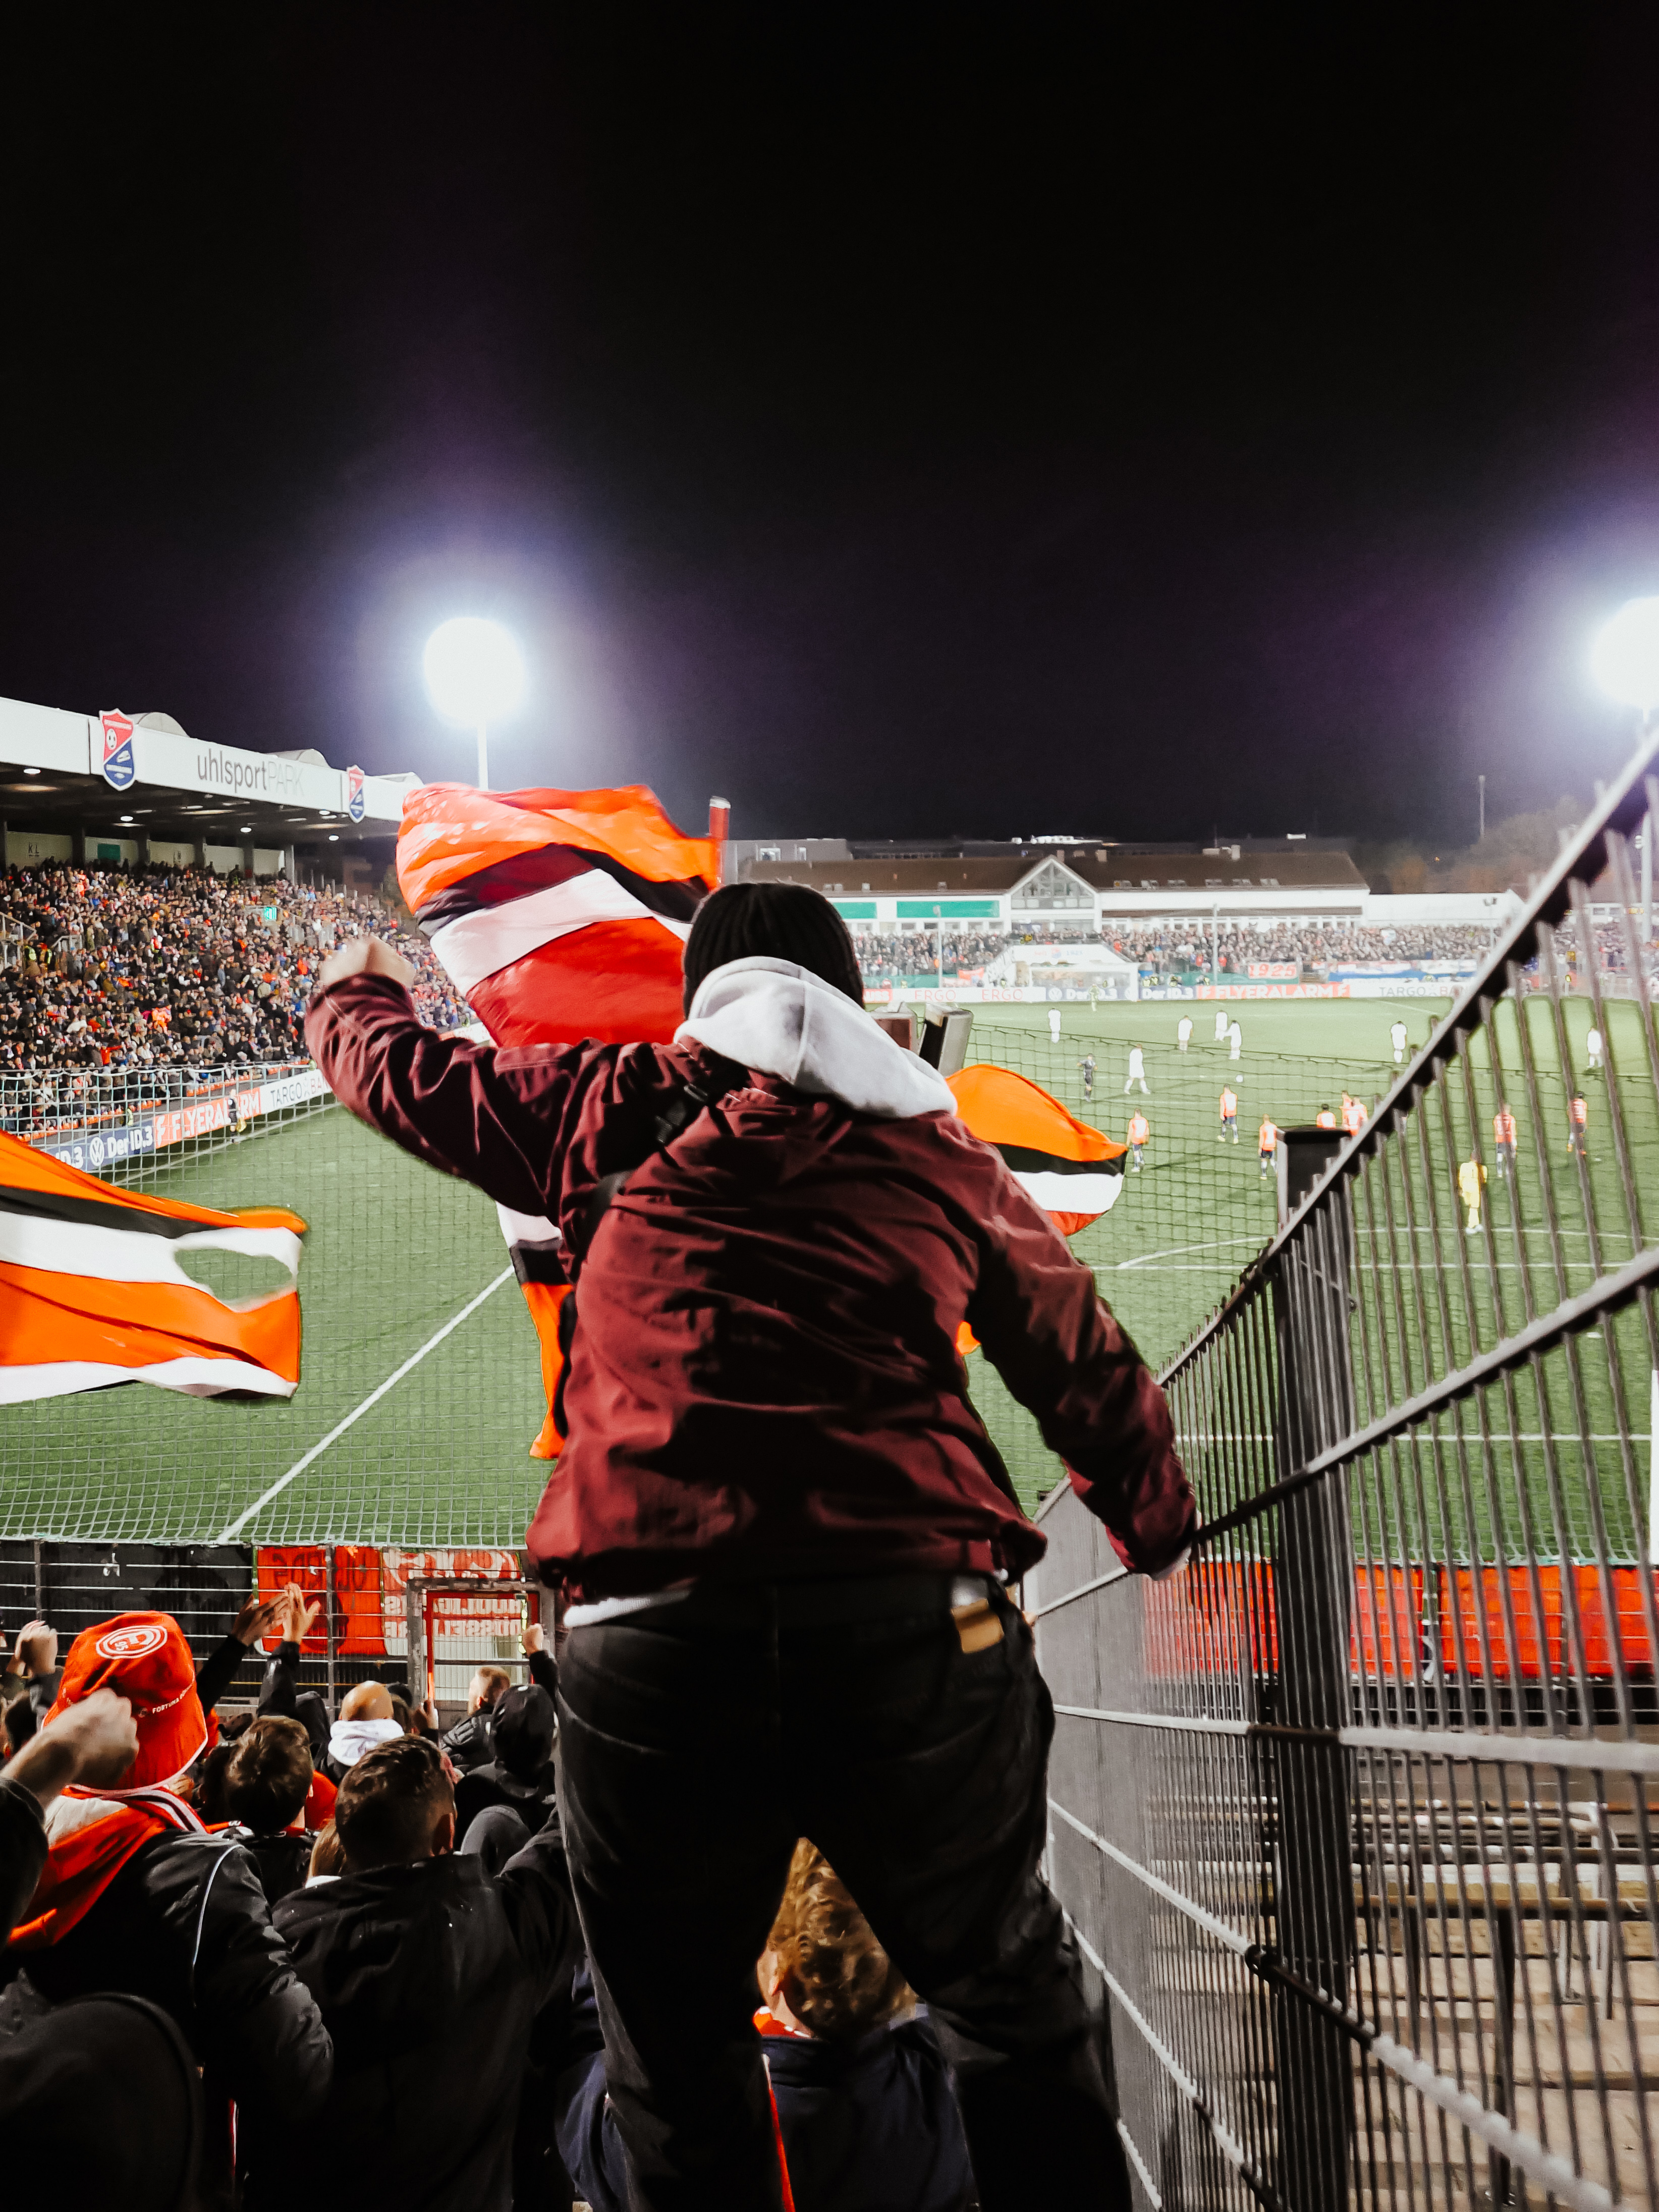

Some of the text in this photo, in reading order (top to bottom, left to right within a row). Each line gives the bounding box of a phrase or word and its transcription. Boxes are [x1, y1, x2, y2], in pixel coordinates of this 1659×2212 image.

[1249, 963, 1296, 977] 1925
[915, 989, 956, 1002] ERGO
[982, 988, 1023, 1001] ERGO
[1066, 988, 1089, 1000] Der
[1142, 988, 1194, 1000] Der ID.3
[1215, 985, 1333, 998] FLYERALARM
[1379, 986, 1426, 997] TARGO
[270, 1076, 331, 1109] TARGO BAN
[172, 1091, 260, 1141] FLYERALRM
[107, 1136, 129, 1158] Der
[130, 1125, 153, 1151] ID.3
[152, 1697, 180, 1714] FORTUNA
